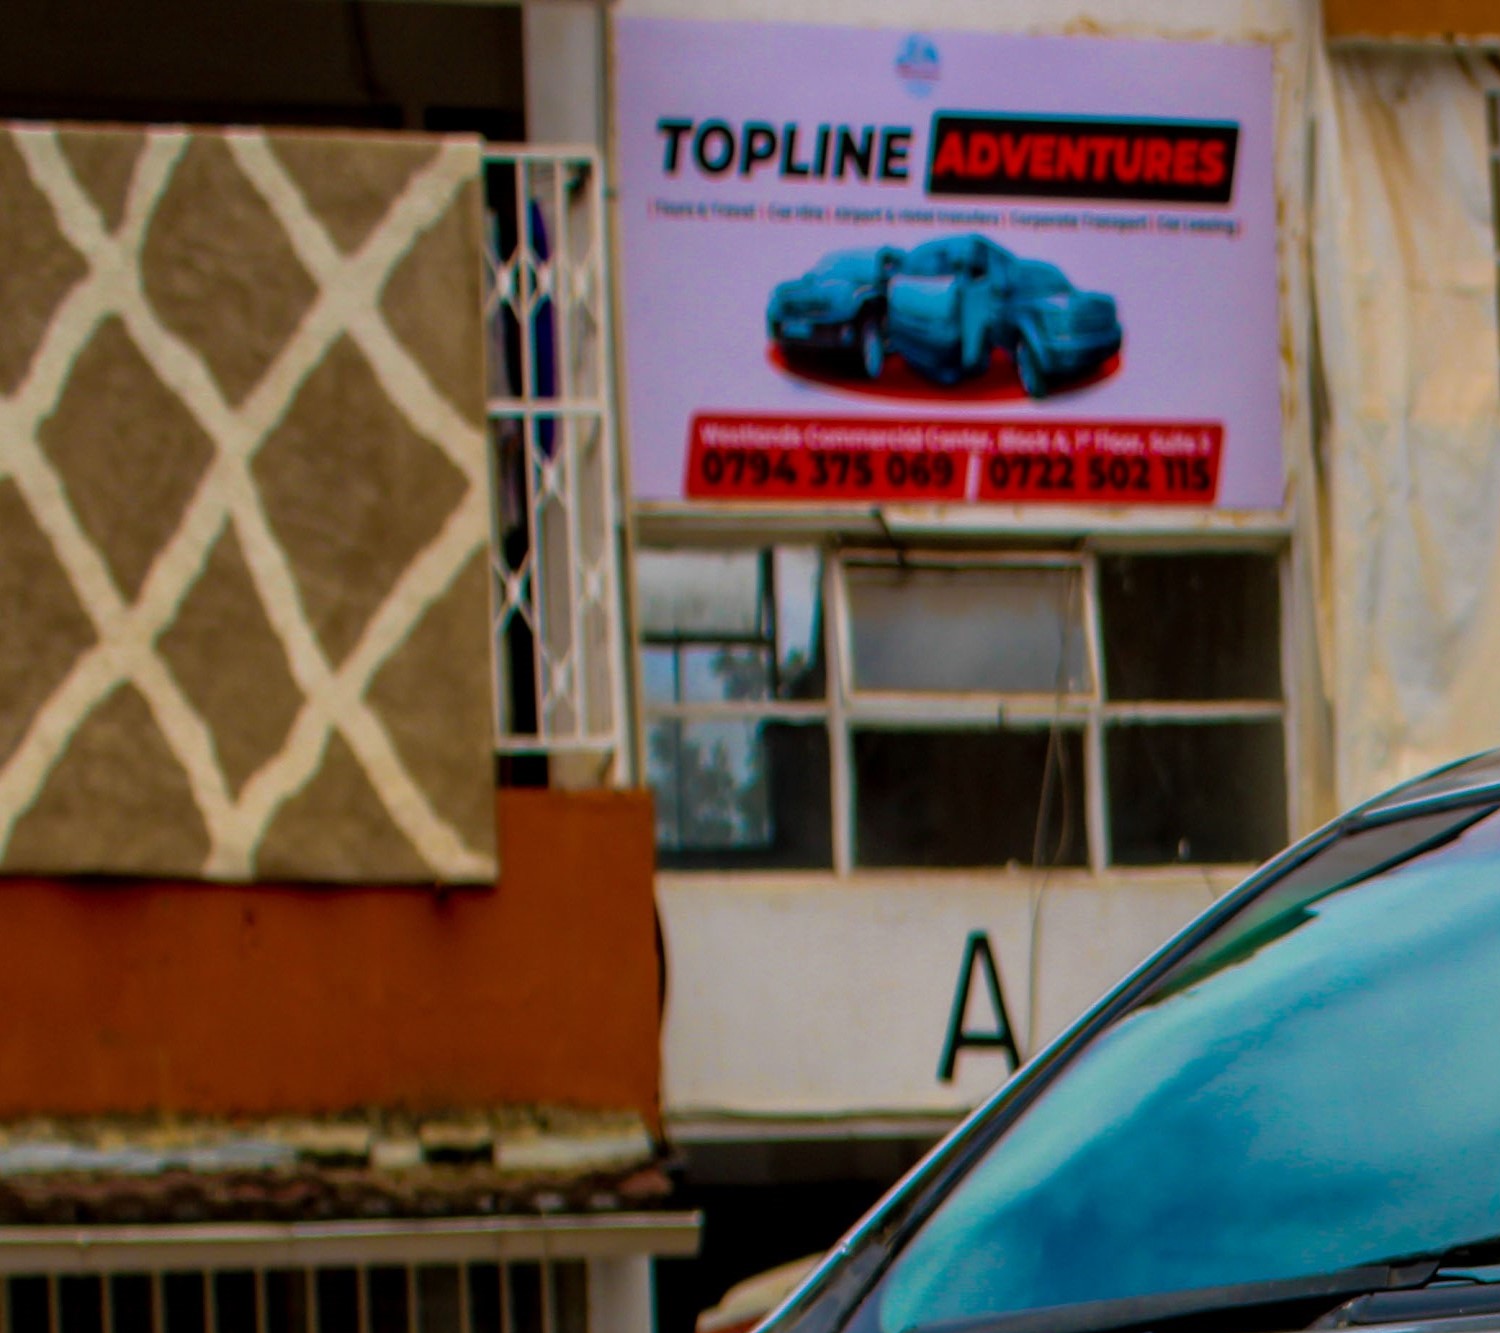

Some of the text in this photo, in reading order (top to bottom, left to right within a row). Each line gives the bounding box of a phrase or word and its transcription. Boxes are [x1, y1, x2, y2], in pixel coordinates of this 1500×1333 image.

[656, 117, 1227, 186] TOPLINE ADVENTURES
[702, 451, 1211, 492] 0794 375 069 0722 502 115
[937, 929, 1021, 1084] A
